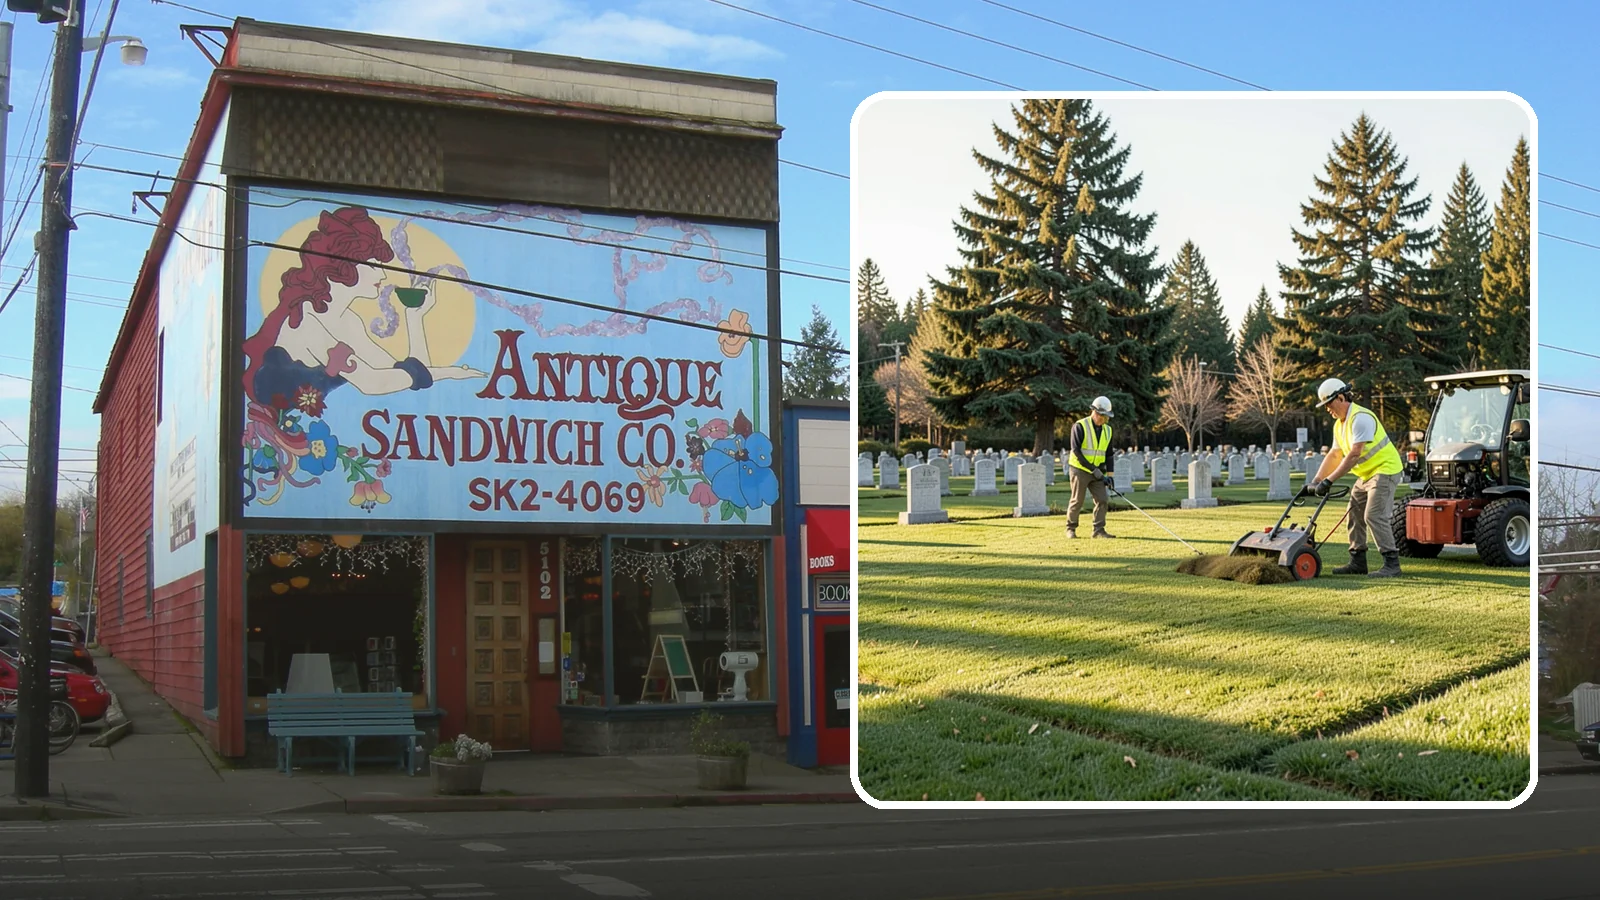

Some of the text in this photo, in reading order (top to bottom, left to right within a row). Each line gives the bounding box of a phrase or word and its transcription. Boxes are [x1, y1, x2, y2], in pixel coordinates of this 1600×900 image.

[476, 329, 723, 421] ANTIQUE
[361, 409, 685, 469] SANDWICH CO.
[468, 478, 646, 513] SK2-4069
[540, 541, 551, 599] 5102
[809, 555, 835, 569] BOOKS
